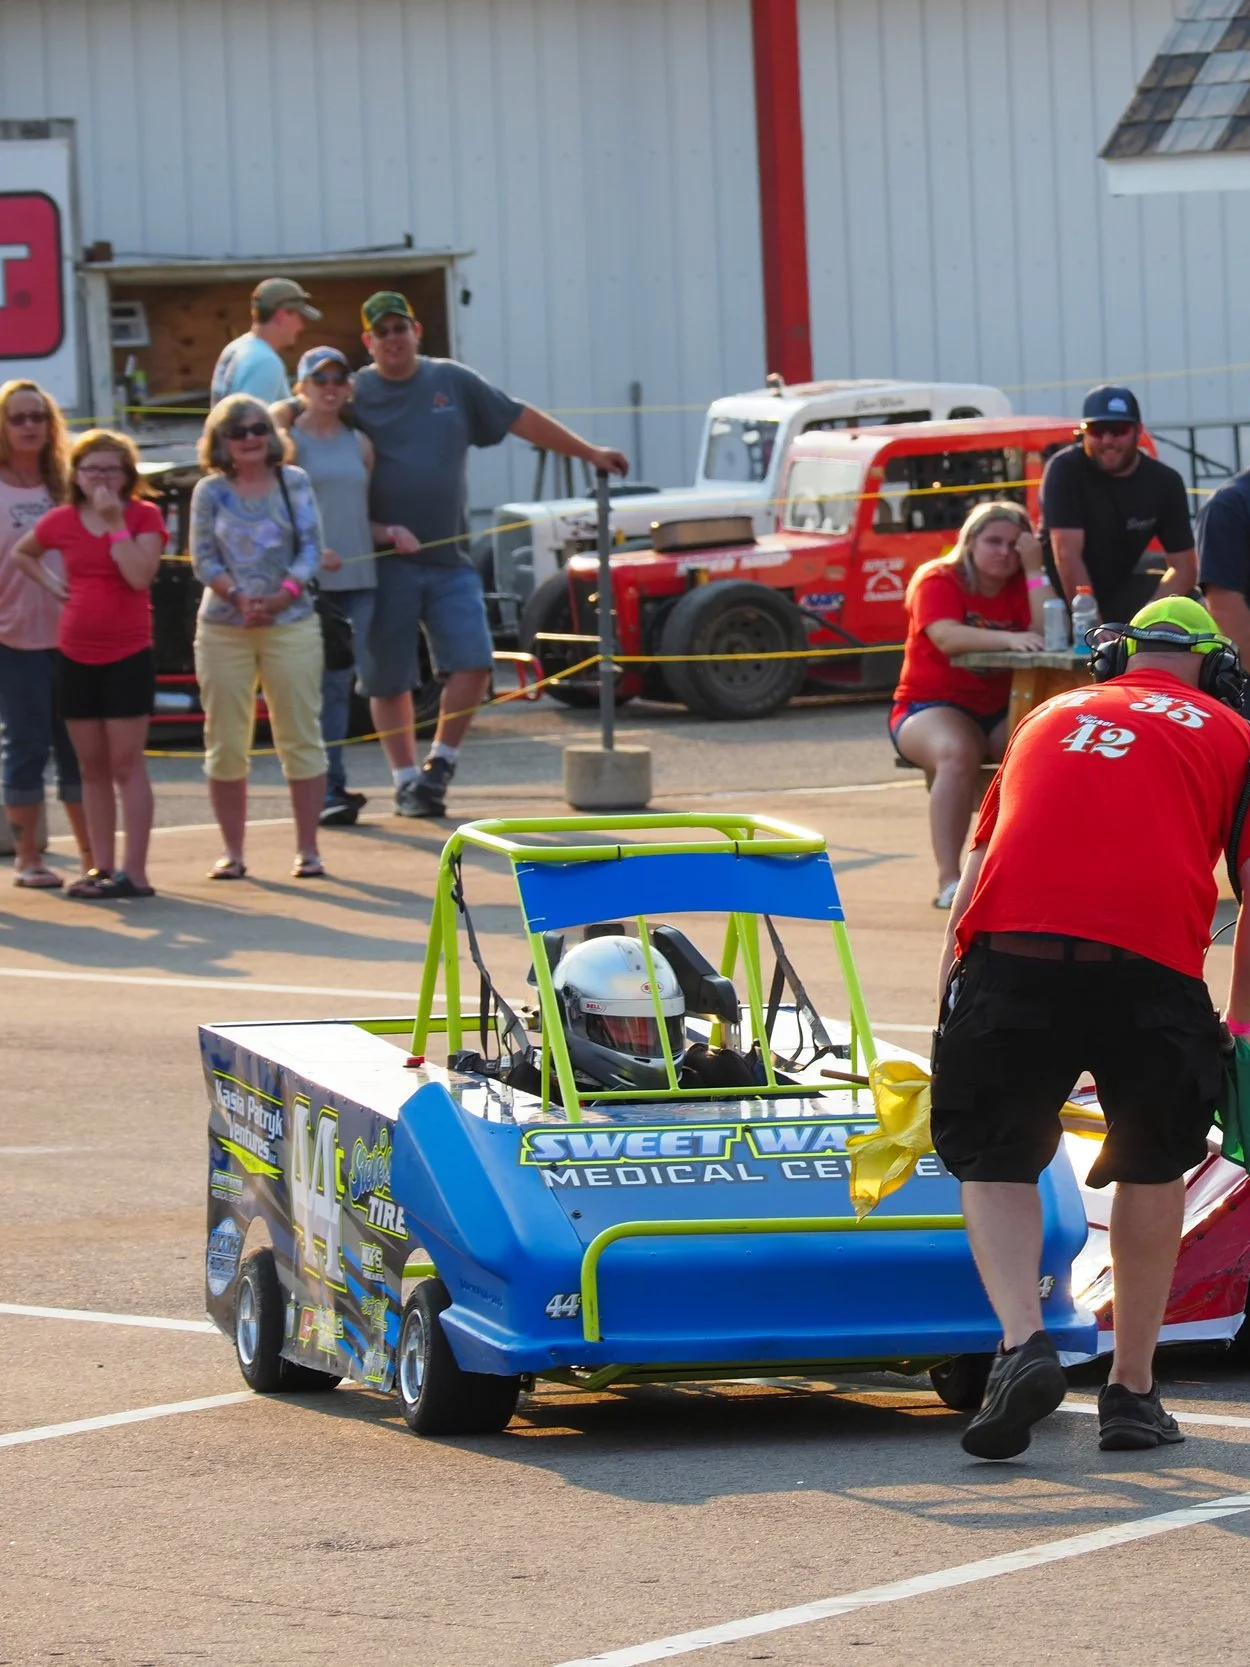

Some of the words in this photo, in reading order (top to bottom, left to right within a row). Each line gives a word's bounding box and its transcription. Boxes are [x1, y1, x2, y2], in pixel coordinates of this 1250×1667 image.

[1129, 694, 1212, 729] 35
[1060, 724, 1136, 759] 42
[215, 1079, 245, 1117] Kasia
[247, 1095, 283, 1140] Patryk
[228, 1112, 270, 1161] Ventures
[533, 1130, 731, 1161] SWEET
[543, 1162, 764, 1188] MEDICAL
[368, 1196, 407, 1236] TIRE
